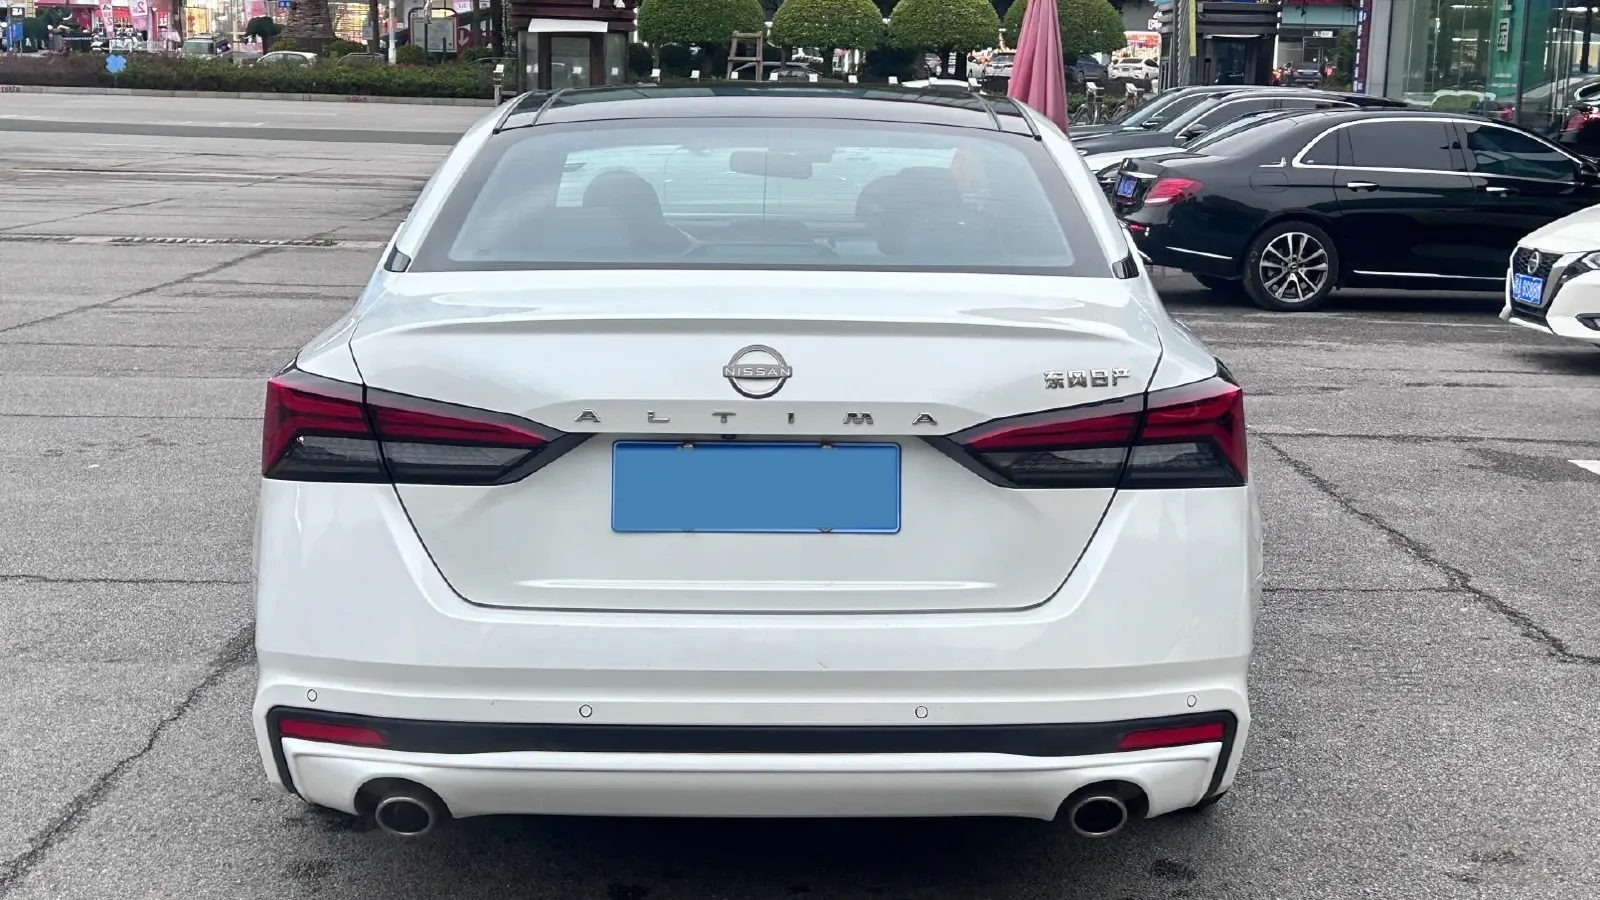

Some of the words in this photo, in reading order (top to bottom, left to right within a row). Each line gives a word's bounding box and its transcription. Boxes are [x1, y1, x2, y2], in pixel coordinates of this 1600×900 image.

[724, 366, 791, 377] NISSAN
[1043, 367, 1130, 389] 东风日产
[574, 408, 938, 425] ALTIMA
